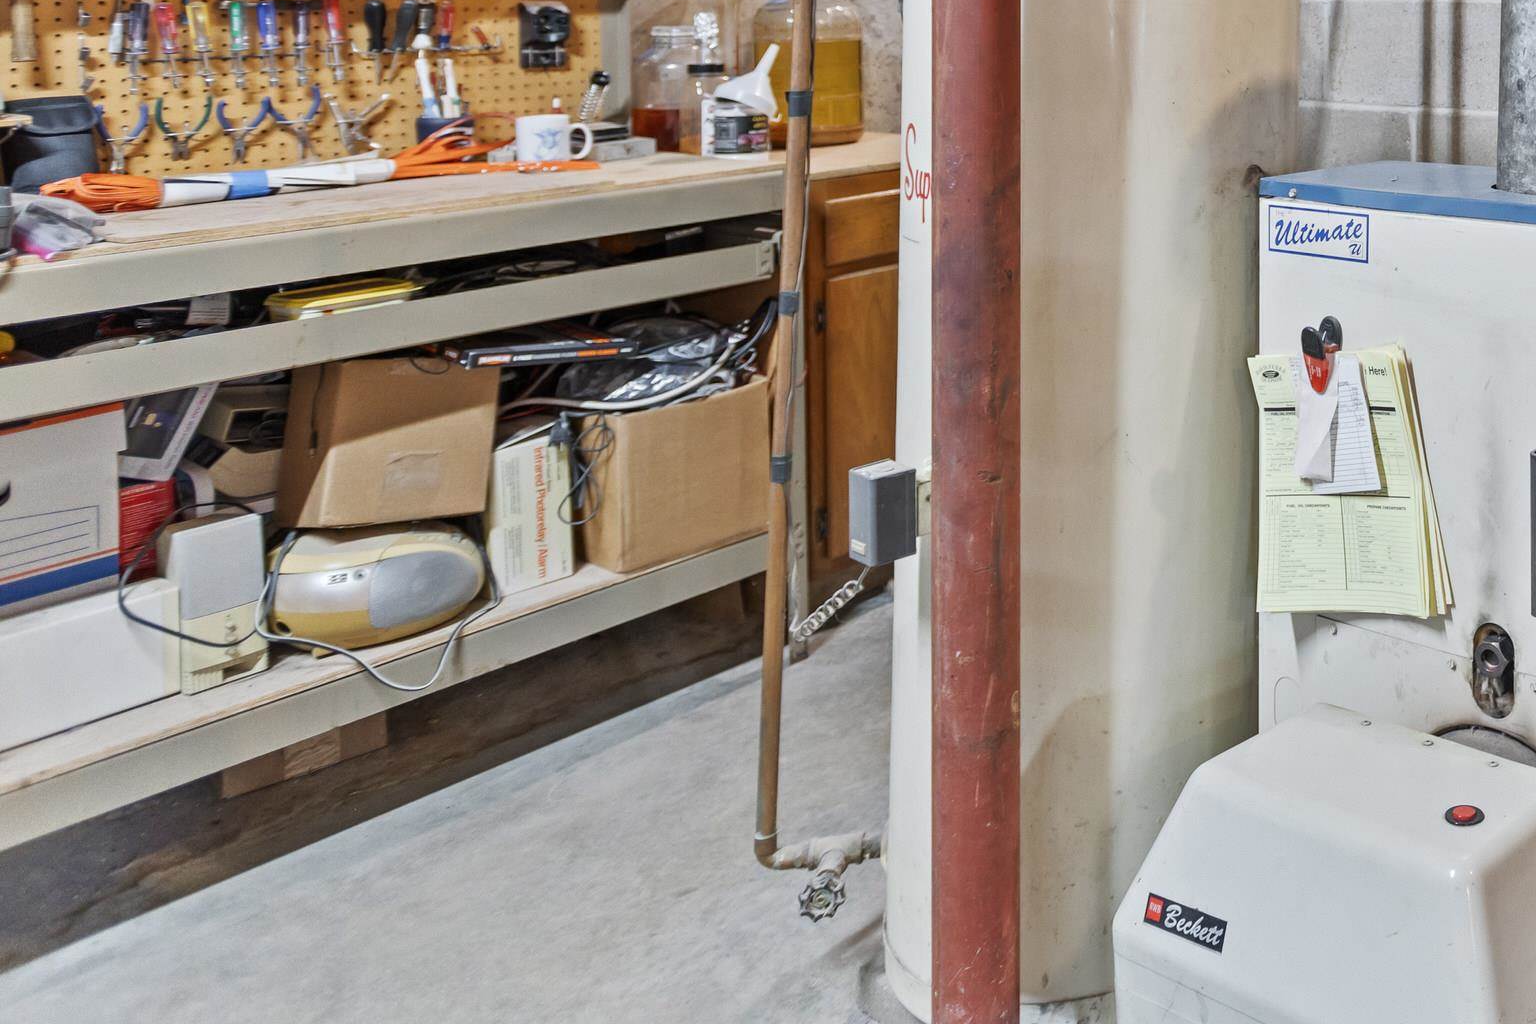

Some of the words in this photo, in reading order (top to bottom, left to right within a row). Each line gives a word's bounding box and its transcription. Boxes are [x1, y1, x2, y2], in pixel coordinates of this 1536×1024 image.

[904, 122, 932, 224] Sup
[1274, 219, 1364, 247] Ultimate
[1368, 366, 1388, 377] Here!
[533, 446, 545, 487] Infrared
[534, 487, 547, 544] Photorelay
[537, 549, 549, 579] Alarm
[1163, 903, 1224, 946] Beckett
